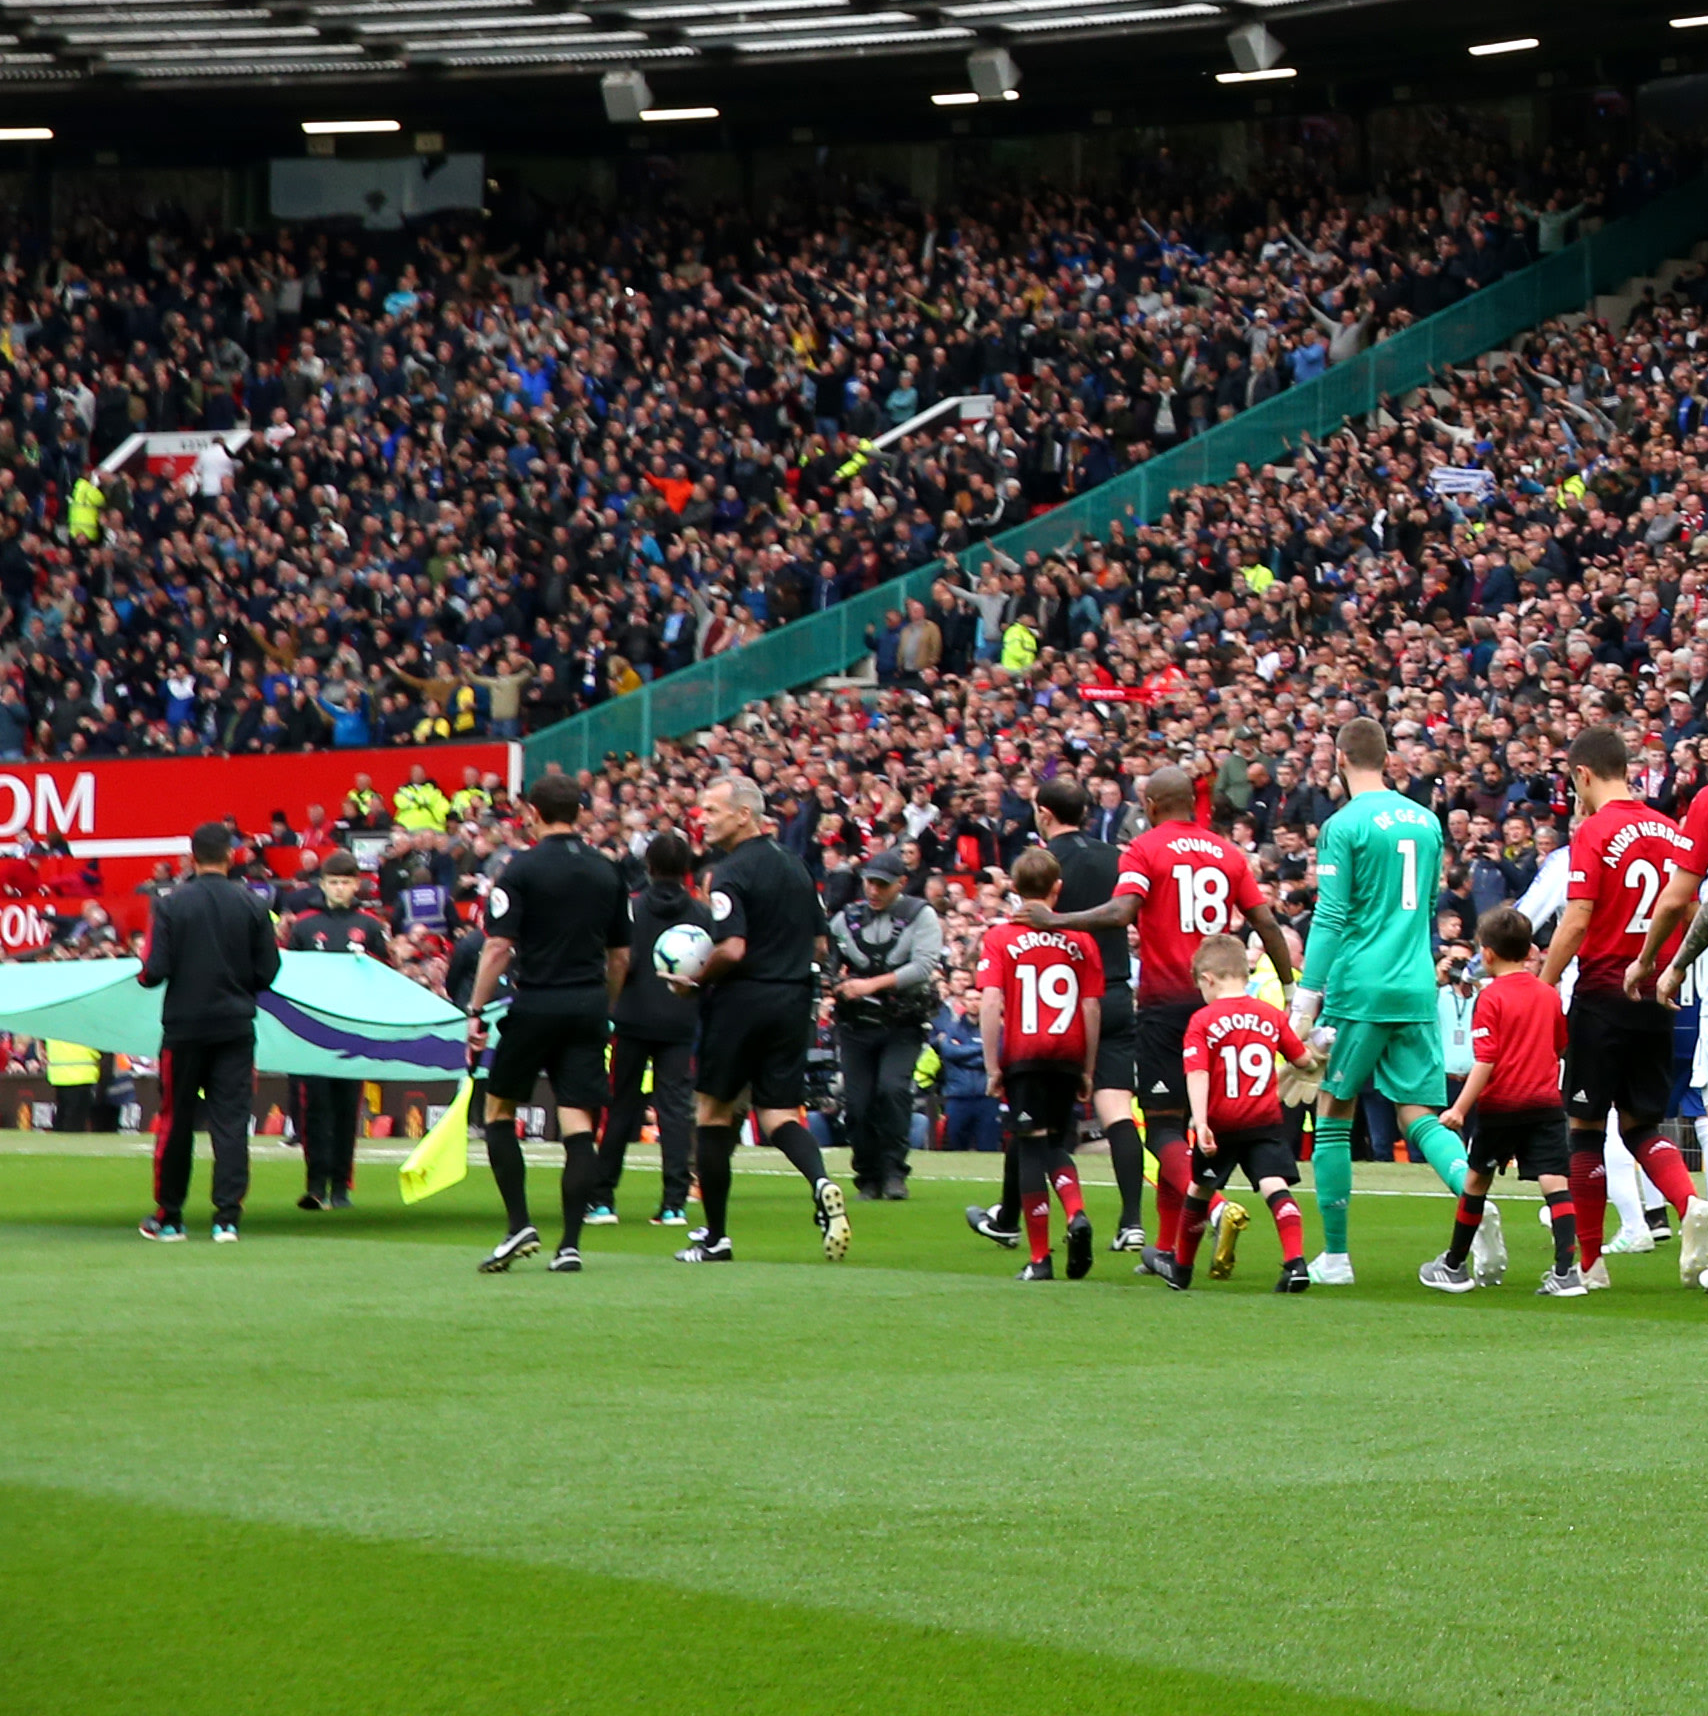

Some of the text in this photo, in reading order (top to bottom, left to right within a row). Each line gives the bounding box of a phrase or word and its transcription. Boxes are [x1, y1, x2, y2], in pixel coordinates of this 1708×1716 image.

[1373, 808, 1429, 831] DE GEA
[1602, 820, 1677, 869] ANDER HERR
[1166, 837, 1224, 860] YOUNG
[1397, 839, 1418, 911] 1
[1172, 864, 1230, 936] 18
[1006, 931, 1085, 962] AEROFLOT
[1015, 963, 1080, 1035] 19
[1220, 1042, 1273, 1099] 19
